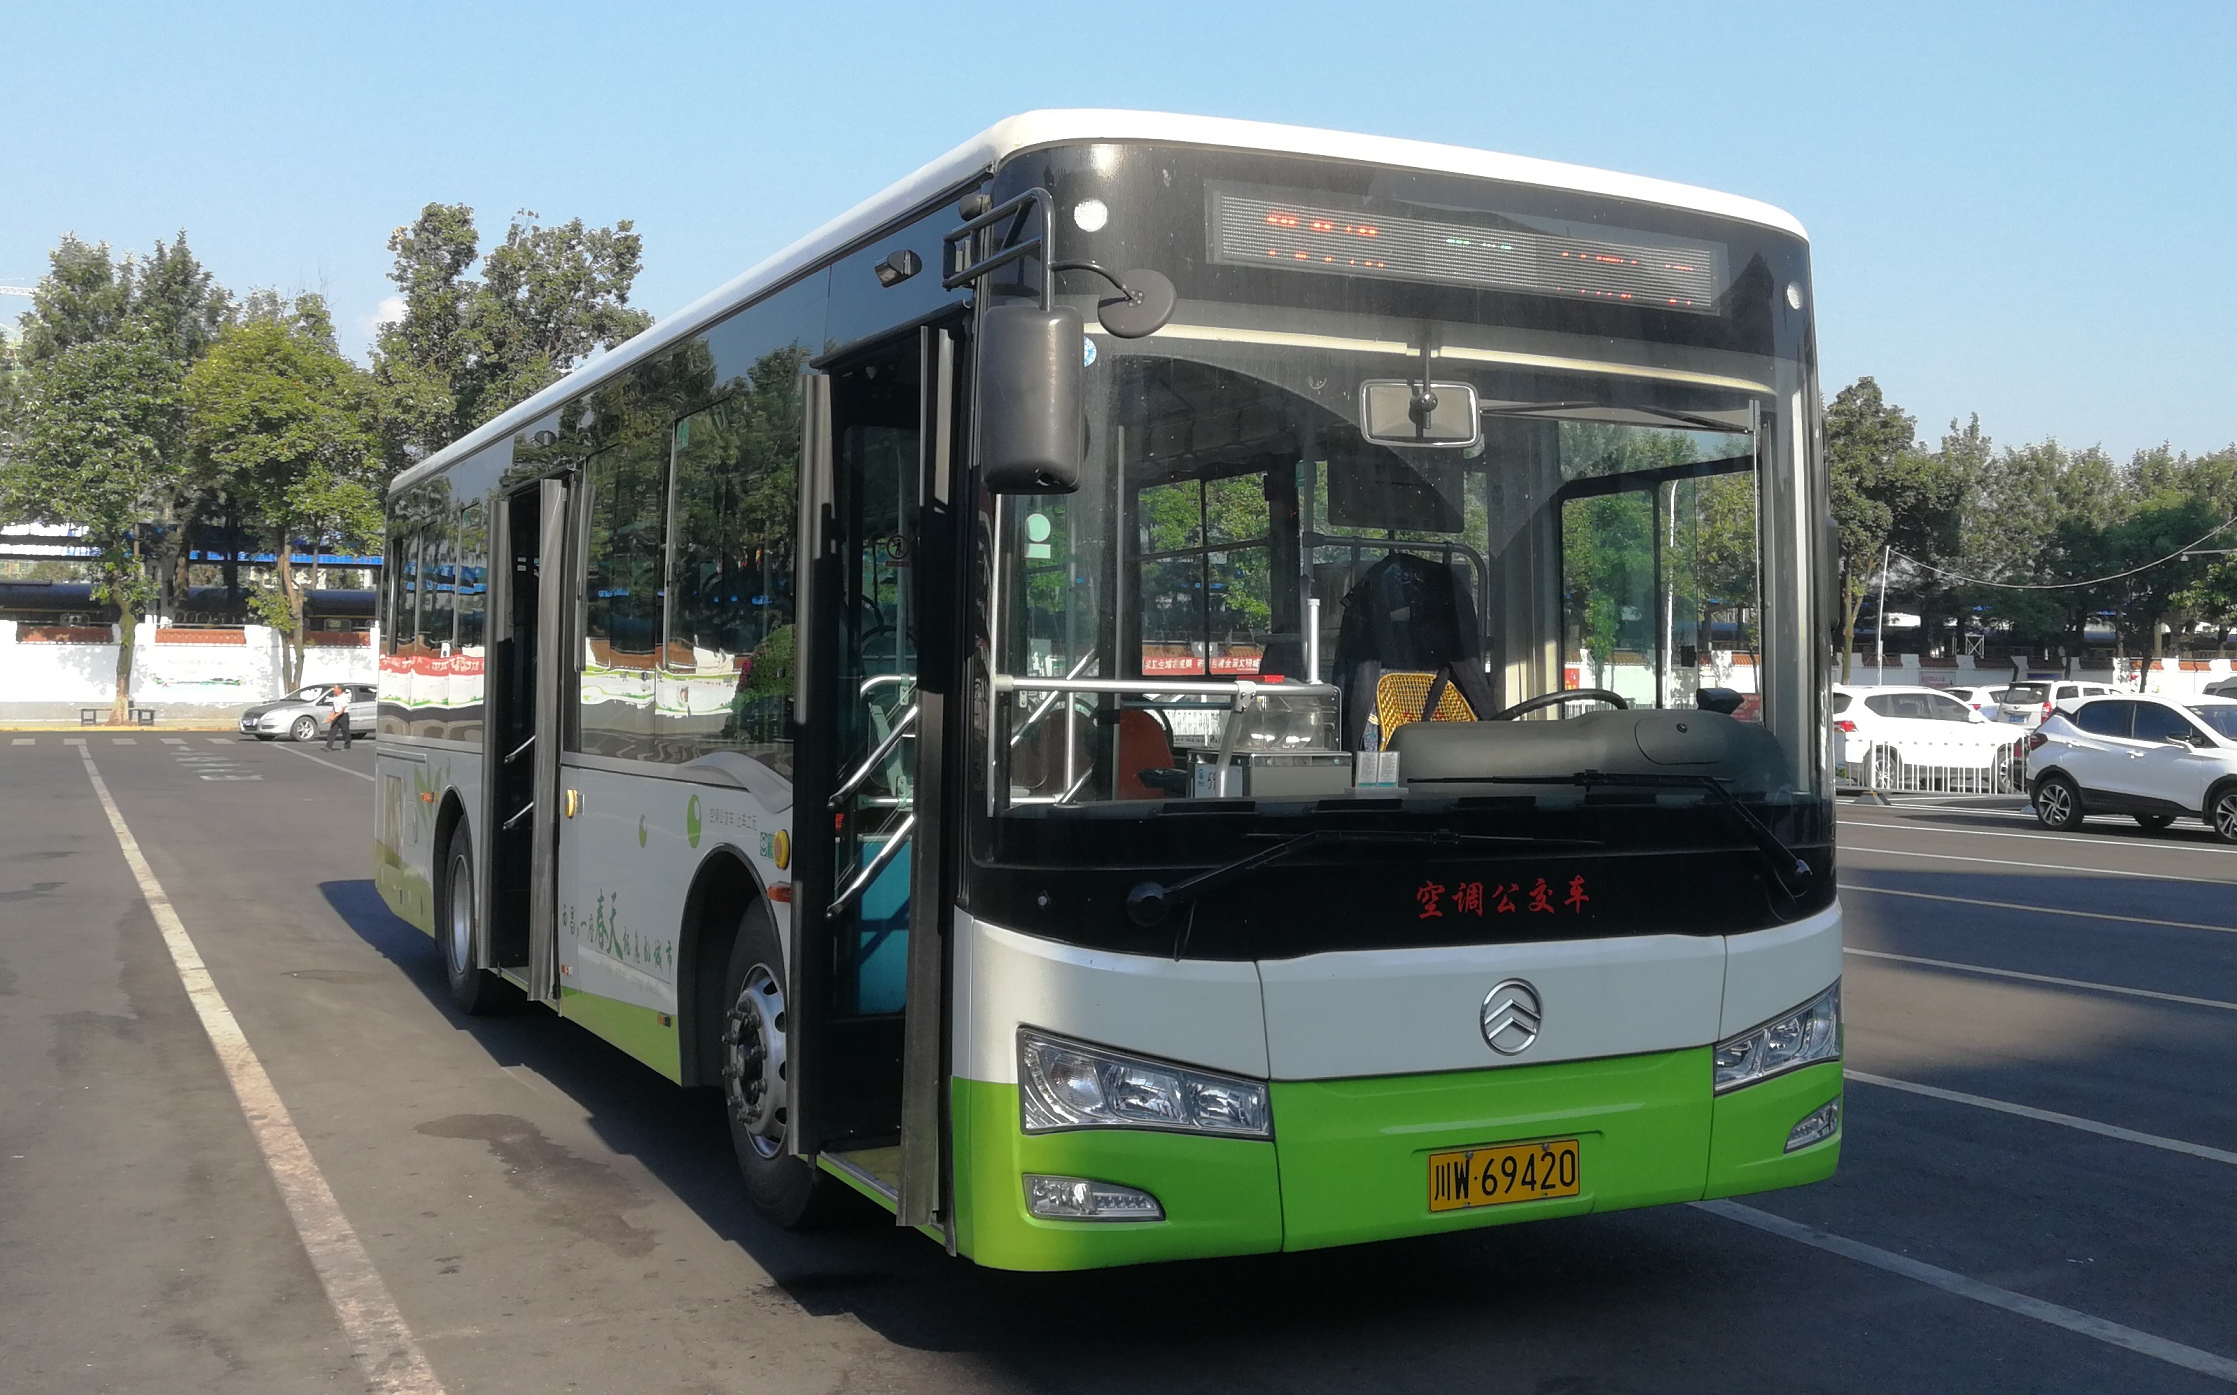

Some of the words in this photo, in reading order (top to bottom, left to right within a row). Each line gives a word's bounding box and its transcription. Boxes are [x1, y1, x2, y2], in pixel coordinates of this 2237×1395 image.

[1416, 874, 1591, 919] 空调公交车
